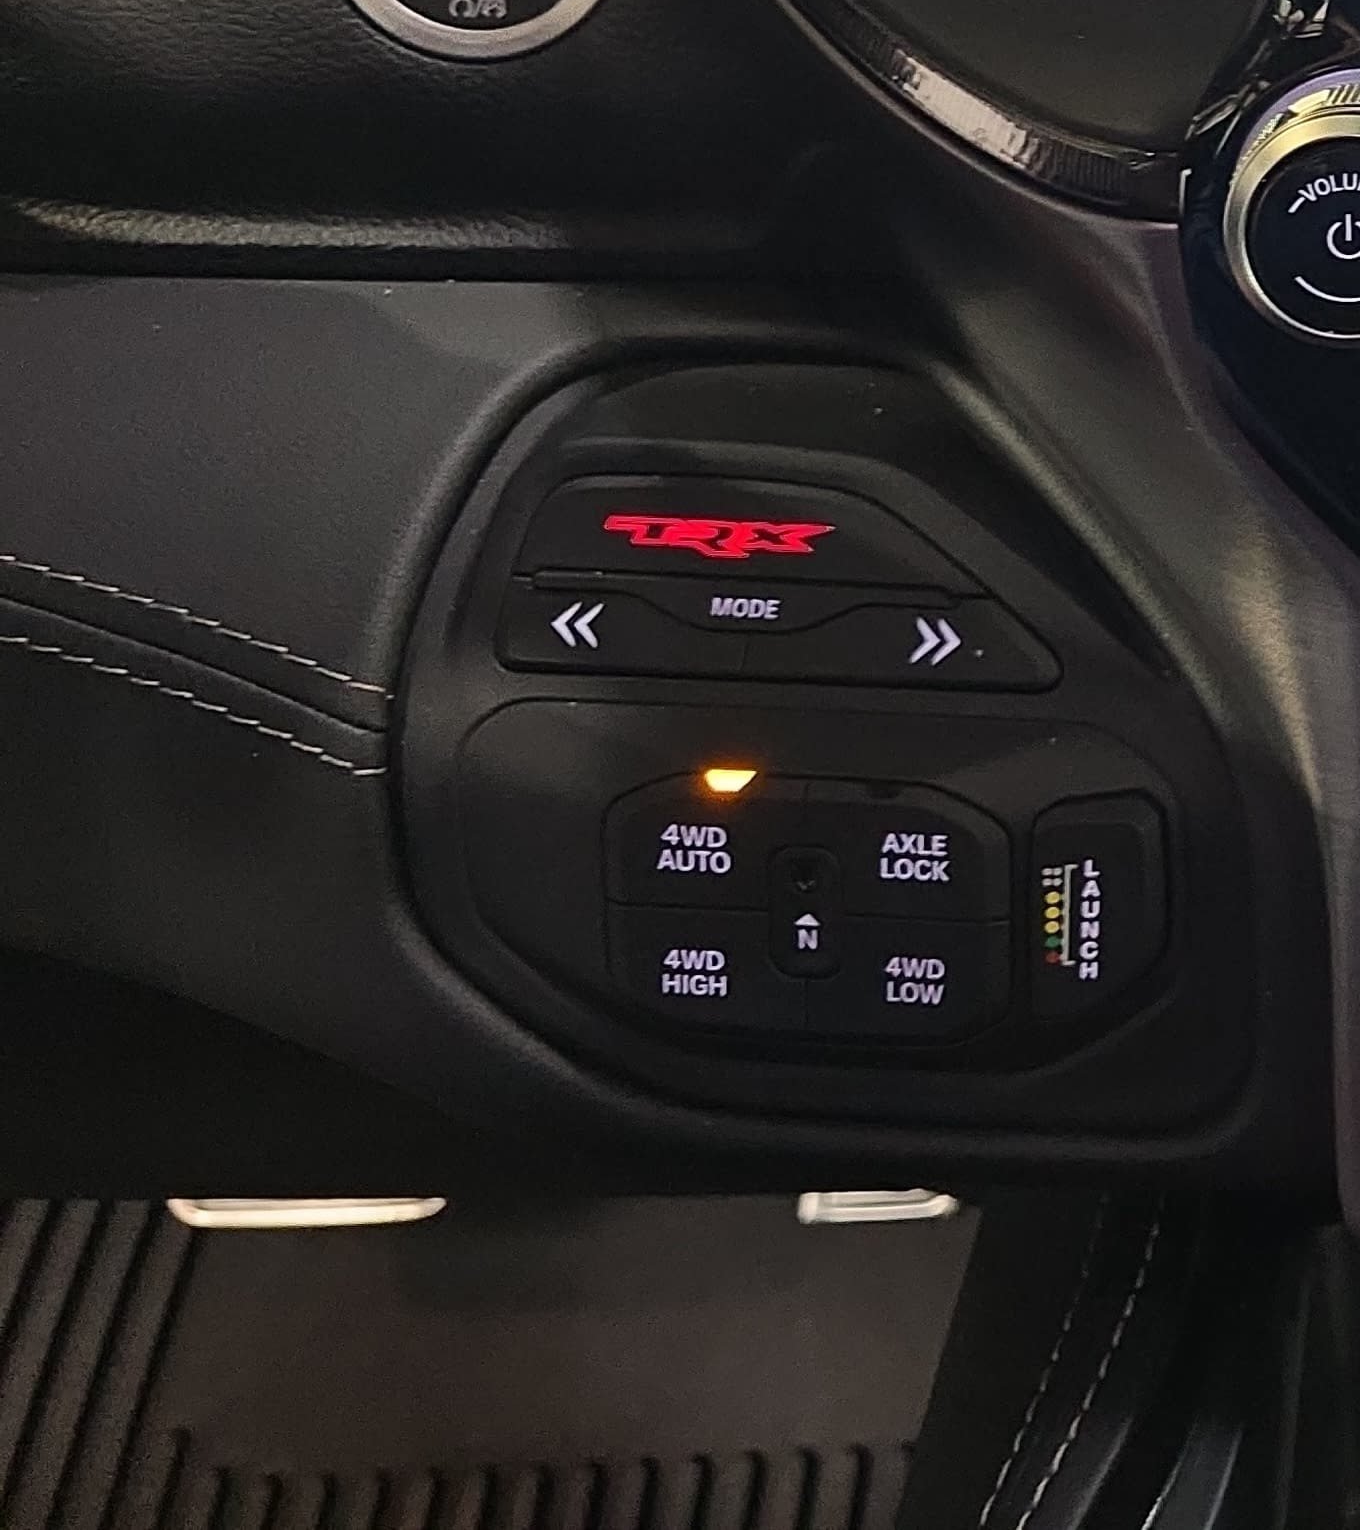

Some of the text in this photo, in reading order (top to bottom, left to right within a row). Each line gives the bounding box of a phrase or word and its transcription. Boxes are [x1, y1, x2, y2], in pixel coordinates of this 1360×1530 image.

[603, 513, 838, 560] TRX
[710, 596, 780, 620] MODE
[660, 824, 728, 848] 4WD
[881, 833, 948, 857] AXLE
[656, 850, 732, 874] AUTO
[879, 859, 951, 882] LOCK
[1079, 858, 1101, 980] LAUNCH
[663, 950, 726, 971] 4WD
[885, 957, 945, 980] 4WD
[661, 974, 728, 998] HIGH
[885, 983, 944, 1005] LOW
